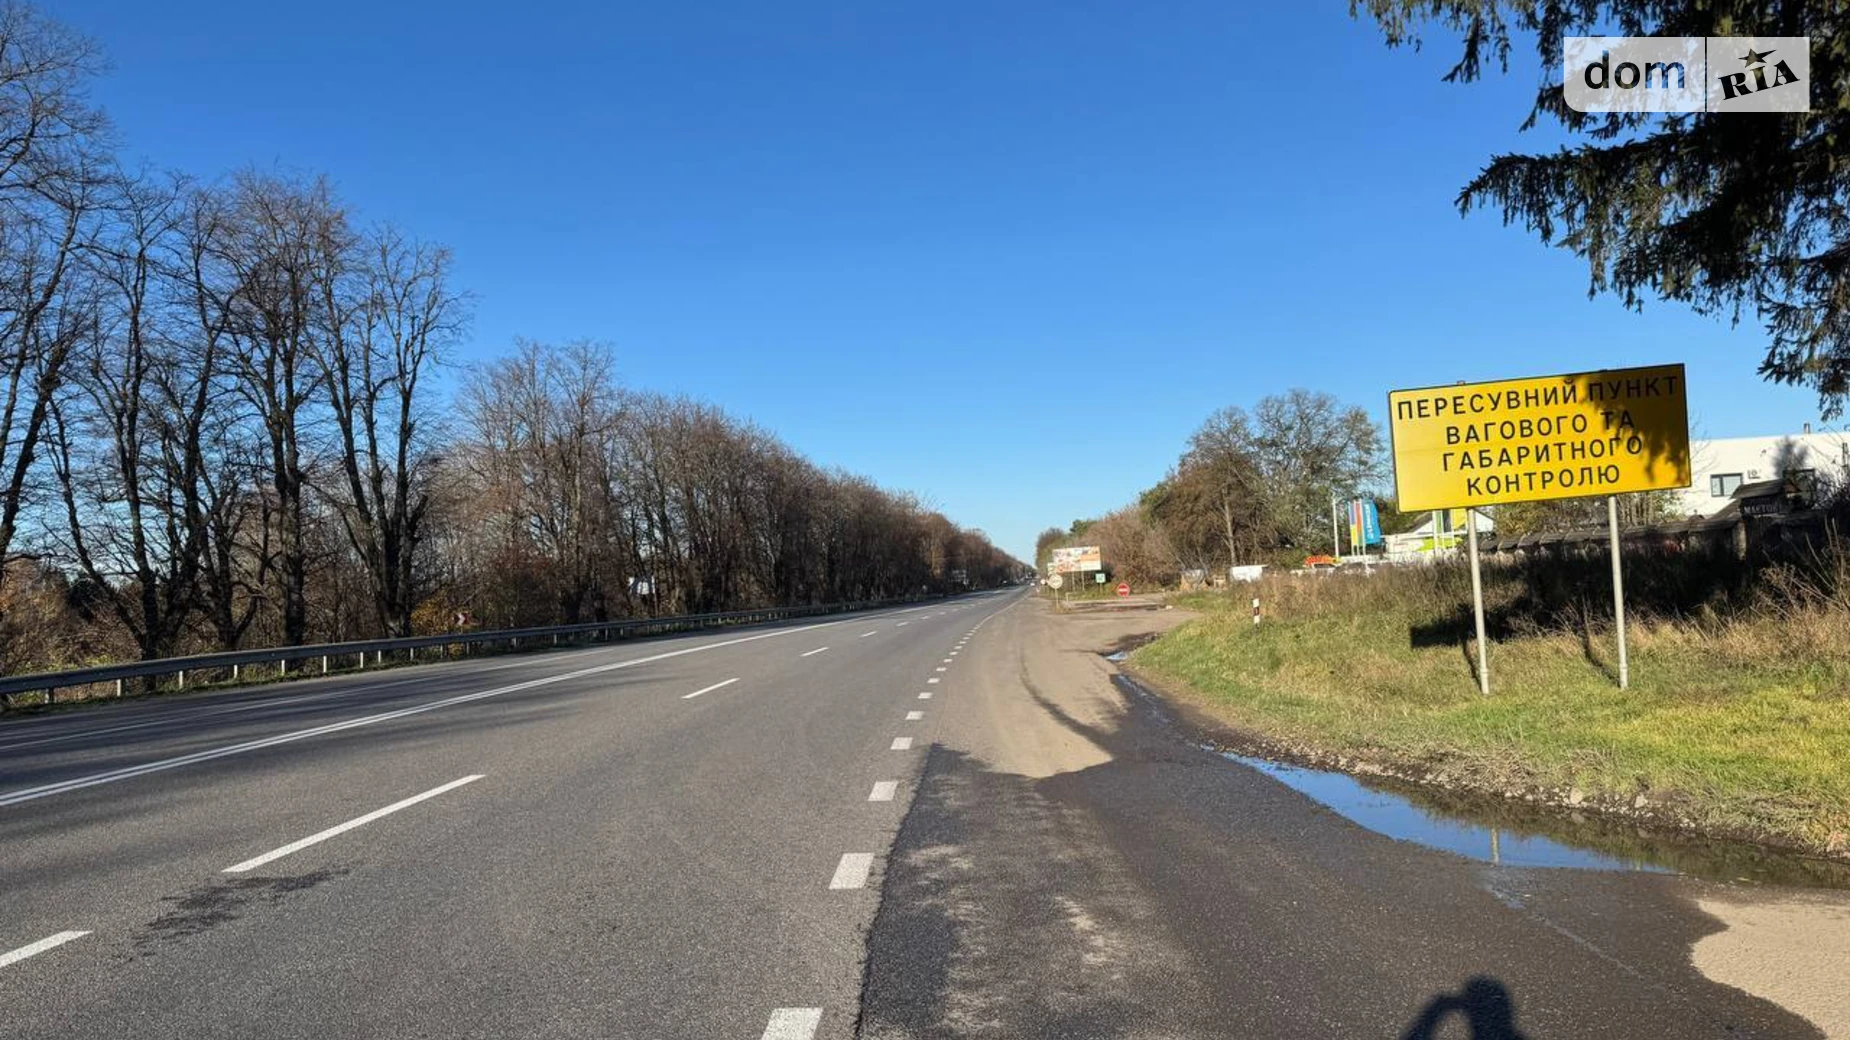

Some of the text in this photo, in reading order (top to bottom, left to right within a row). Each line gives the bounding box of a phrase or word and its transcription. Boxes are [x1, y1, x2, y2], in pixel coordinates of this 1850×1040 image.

[1398, 376, 1678, 420] ПЕРЕСУВНИЙ ПУНКТ
[1446, 410, 1634, 445] ВАГОВОГО ТА
[1442, 435, 1643, 472] ГАБАРИТНОГО
[1467, 464, 1620, 497] КОНТРОЛЮ
